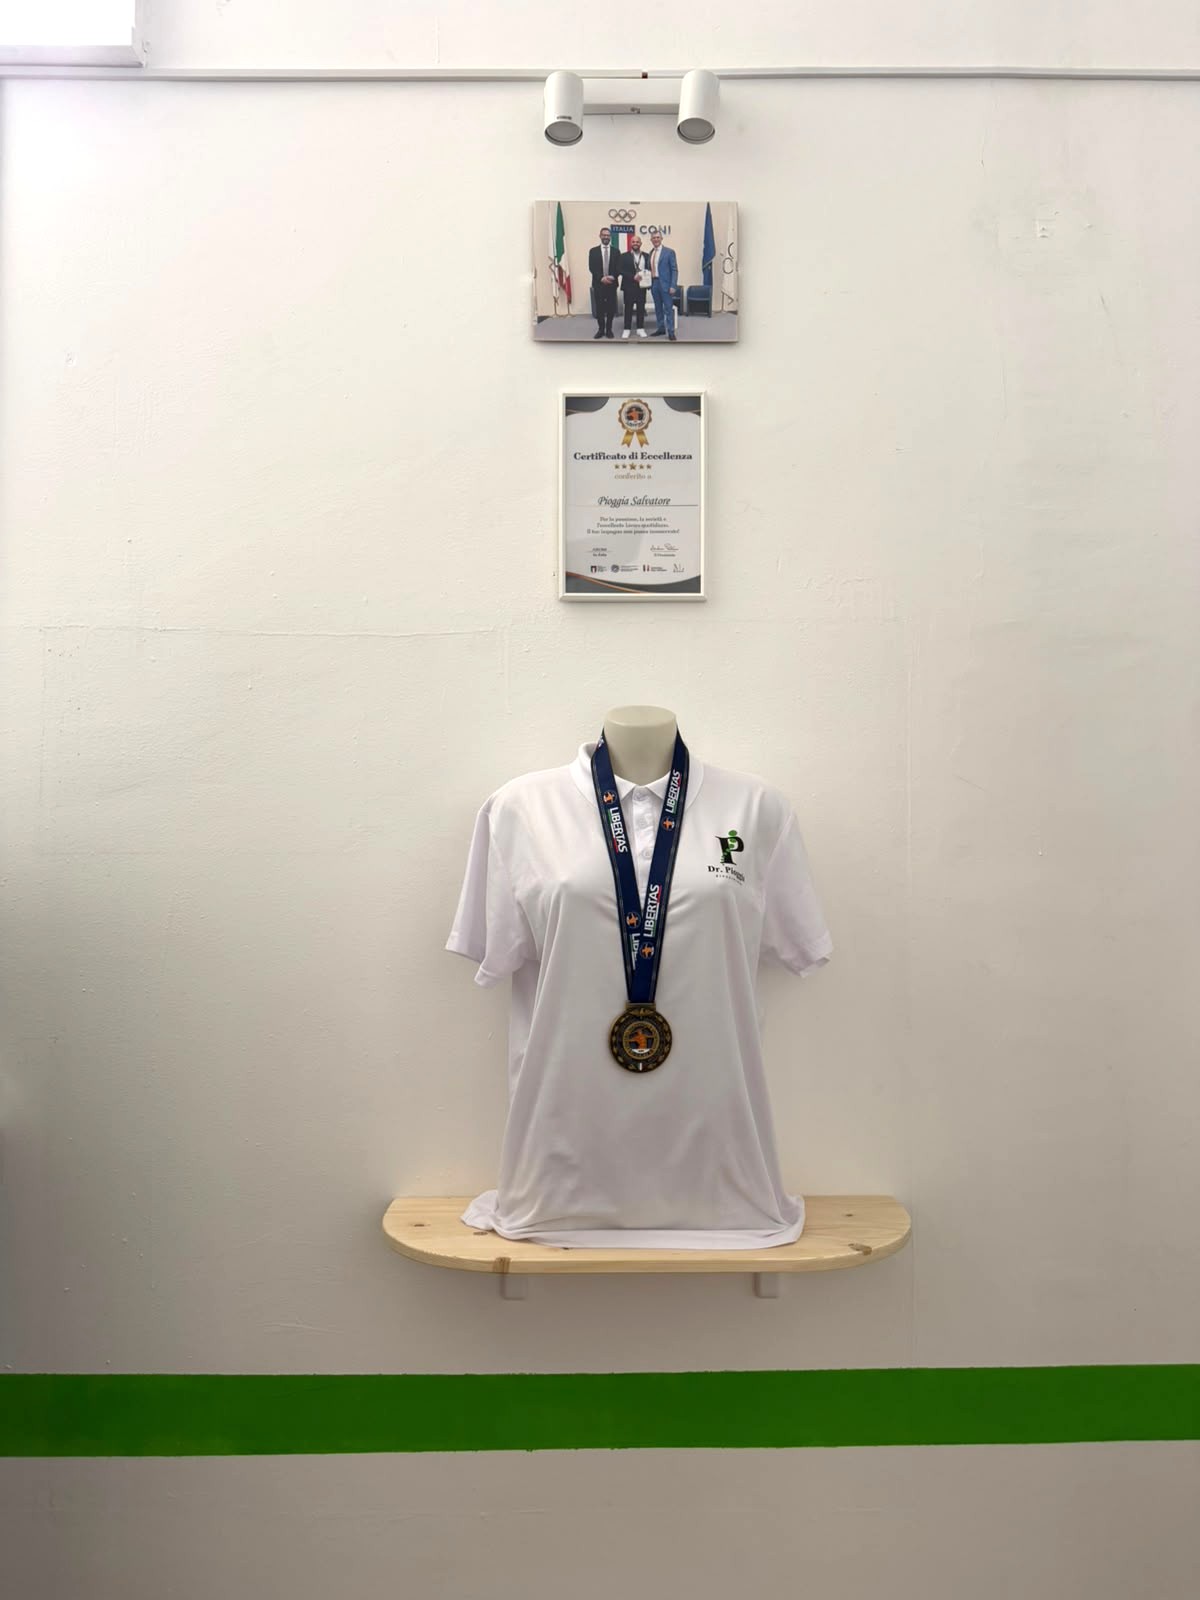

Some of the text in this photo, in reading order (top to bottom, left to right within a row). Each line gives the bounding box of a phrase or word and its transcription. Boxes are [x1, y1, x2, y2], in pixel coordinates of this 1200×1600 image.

[640, 225, 671, 234] CONI
[573, 452, 693, 460] Certificato di Eccellenza
[614, 472, 646, 480] conferito
[597, 495, 671, 508] Pioggia Salvatore
[665, 769, 681, 814] LIBERTAS
[609, 807, 628, 853] LIBERTAS
[643, 884, 660, 937] LIBERTAS
